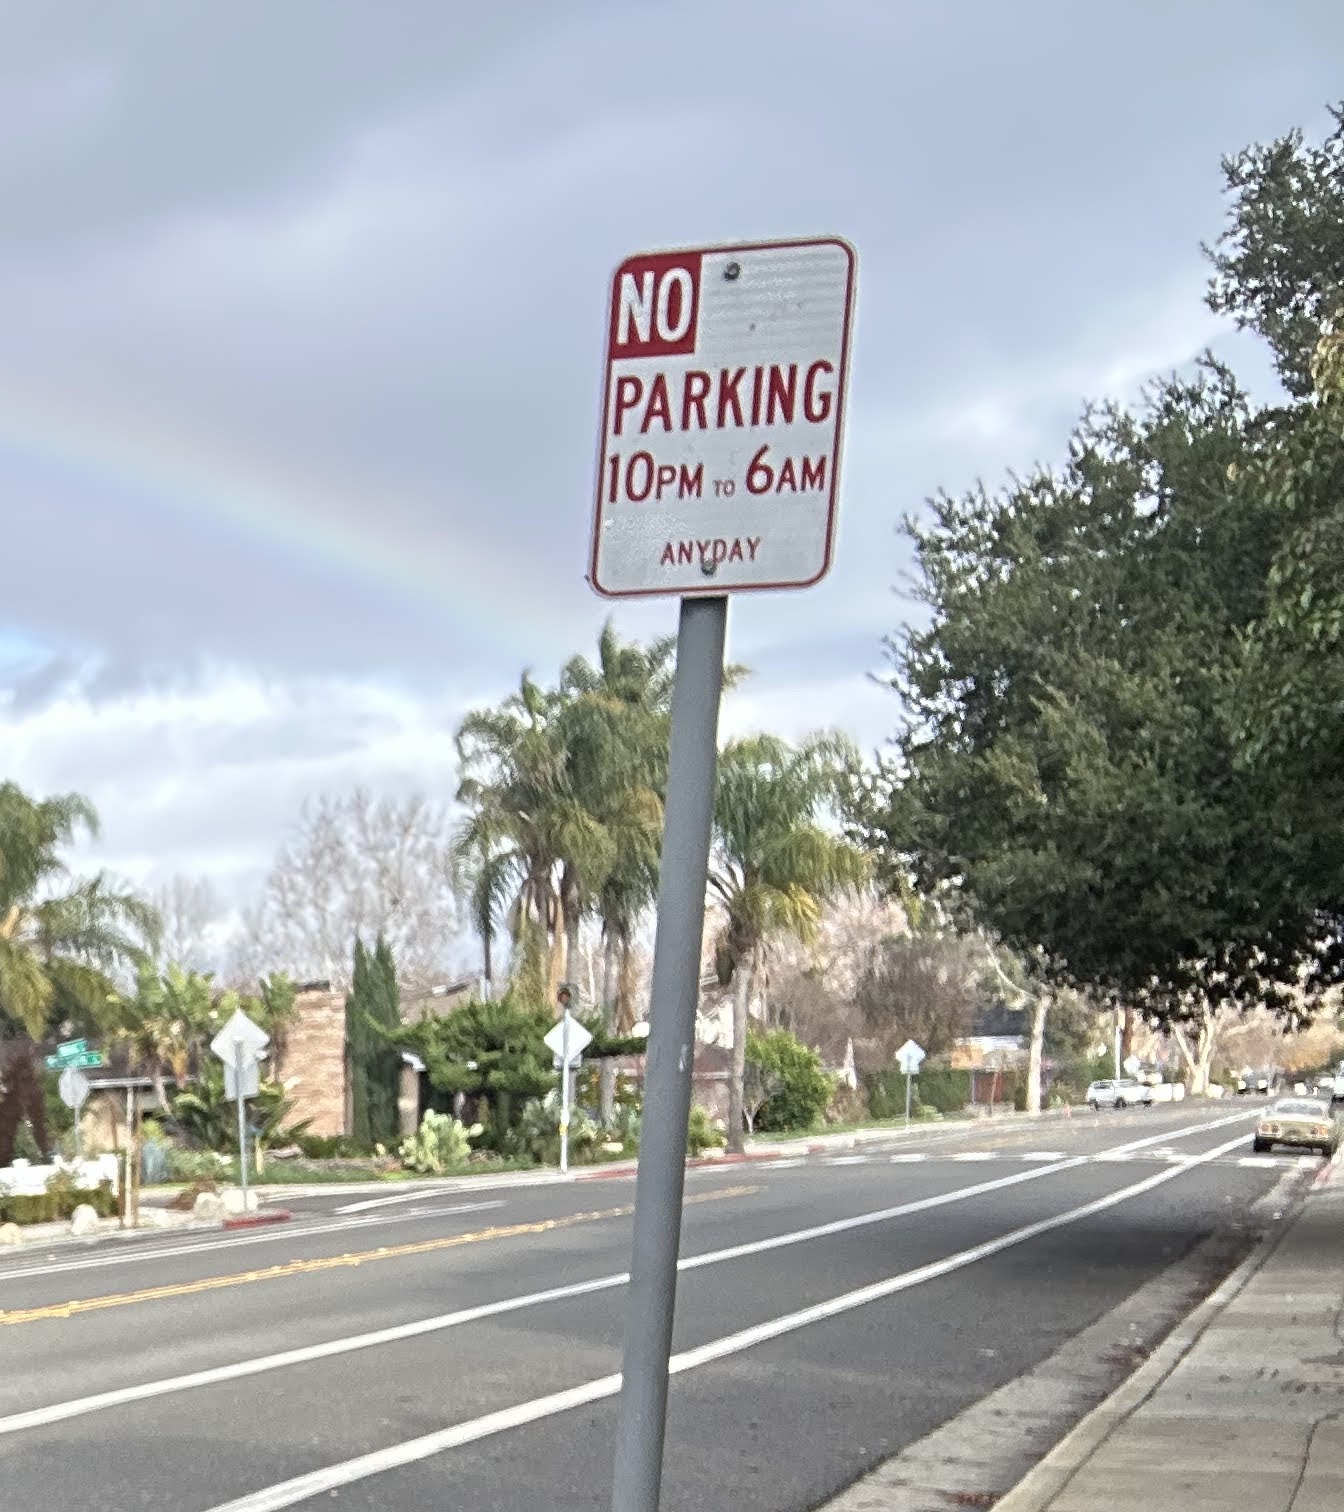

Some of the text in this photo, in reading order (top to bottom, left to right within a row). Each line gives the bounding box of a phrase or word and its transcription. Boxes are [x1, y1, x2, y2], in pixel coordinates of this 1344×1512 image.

[616, 267, 695, 346] NO
[613, 360, 833, 436] PARKING
[609, 450, 704, 503] 10PM
[745, 443, 827, 496] 6AM
[660, 537, 760, 567] ANYDAY
